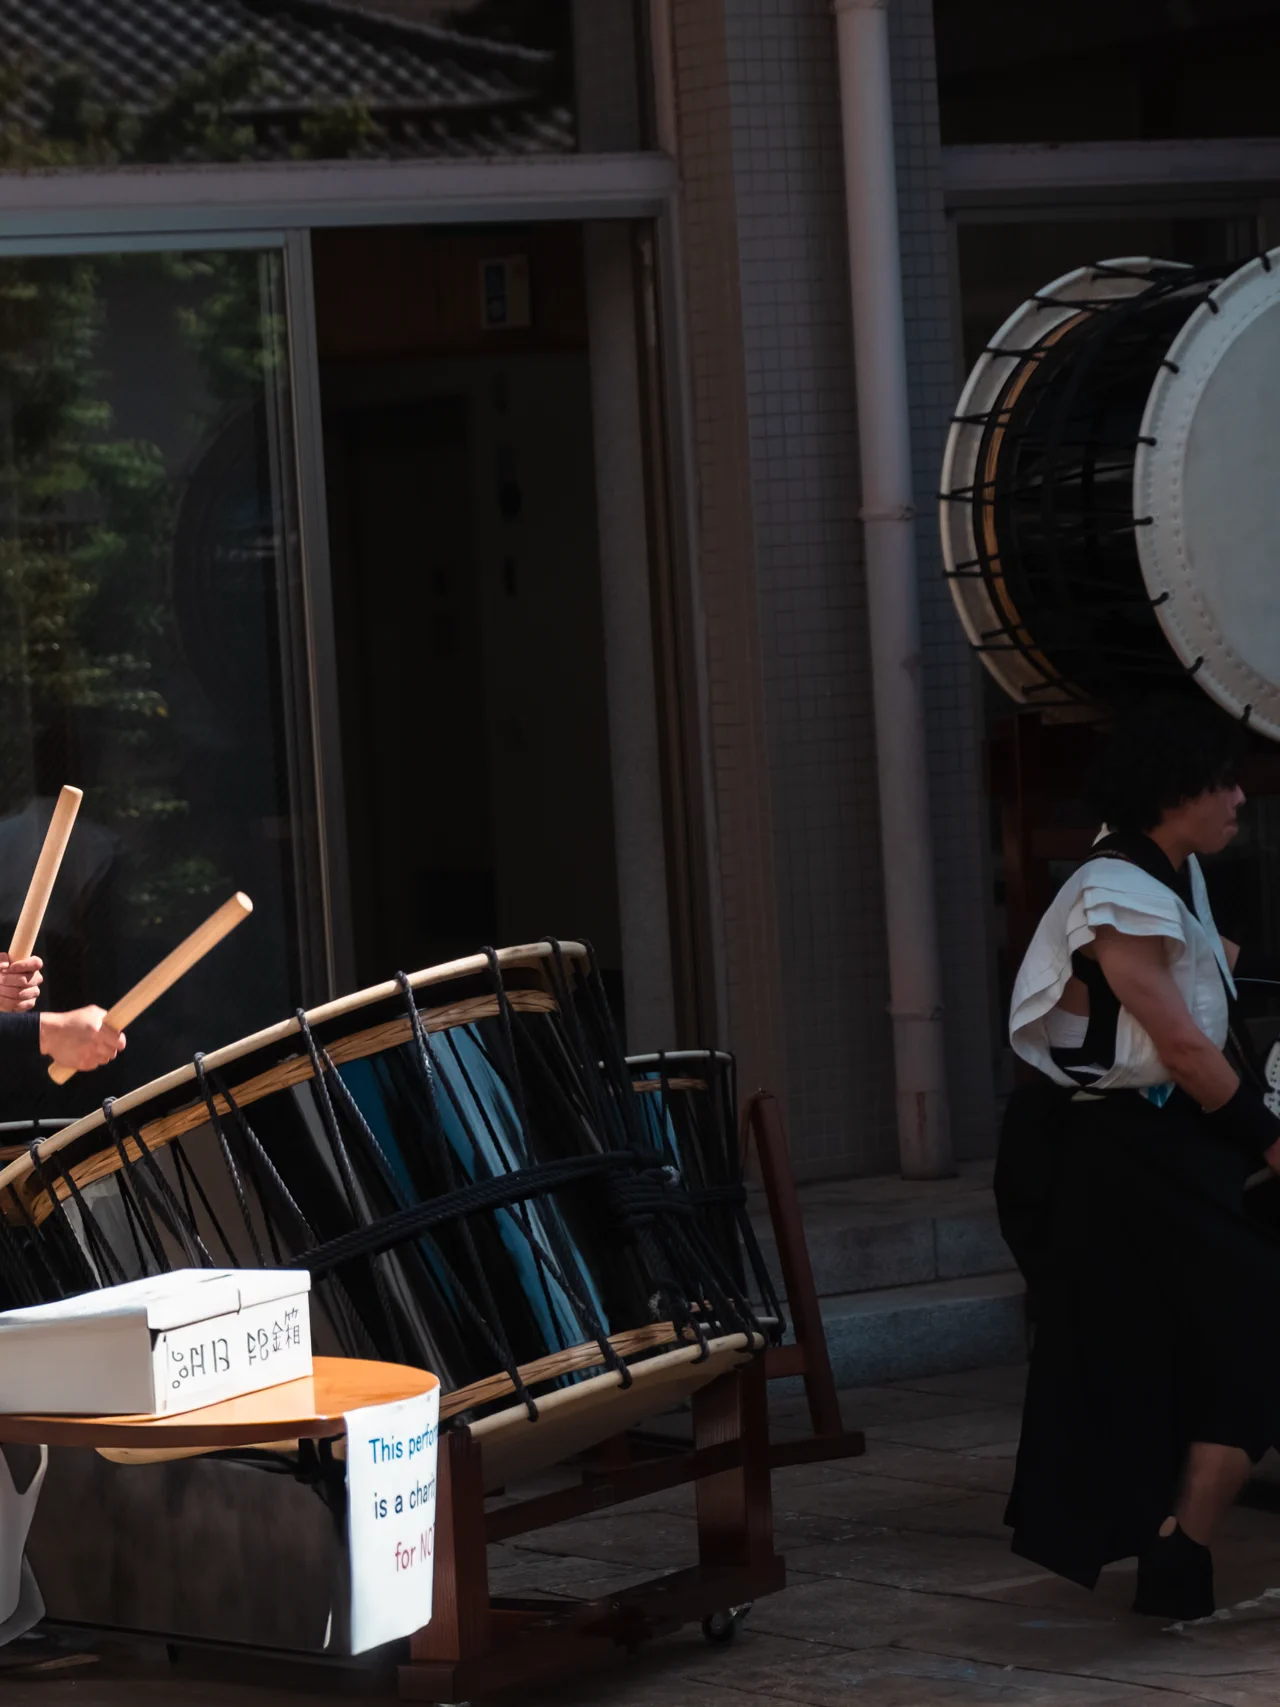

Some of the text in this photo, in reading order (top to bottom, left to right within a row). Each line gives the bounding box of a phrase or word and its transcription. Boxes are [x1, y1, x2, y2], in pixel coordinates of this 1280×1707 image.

[368, 1436, 404, 1465] This
[374, 1492, 389, 1519] is
[394, 1494, 404, 1515] a
[394, 1541, 417, 1572] for
